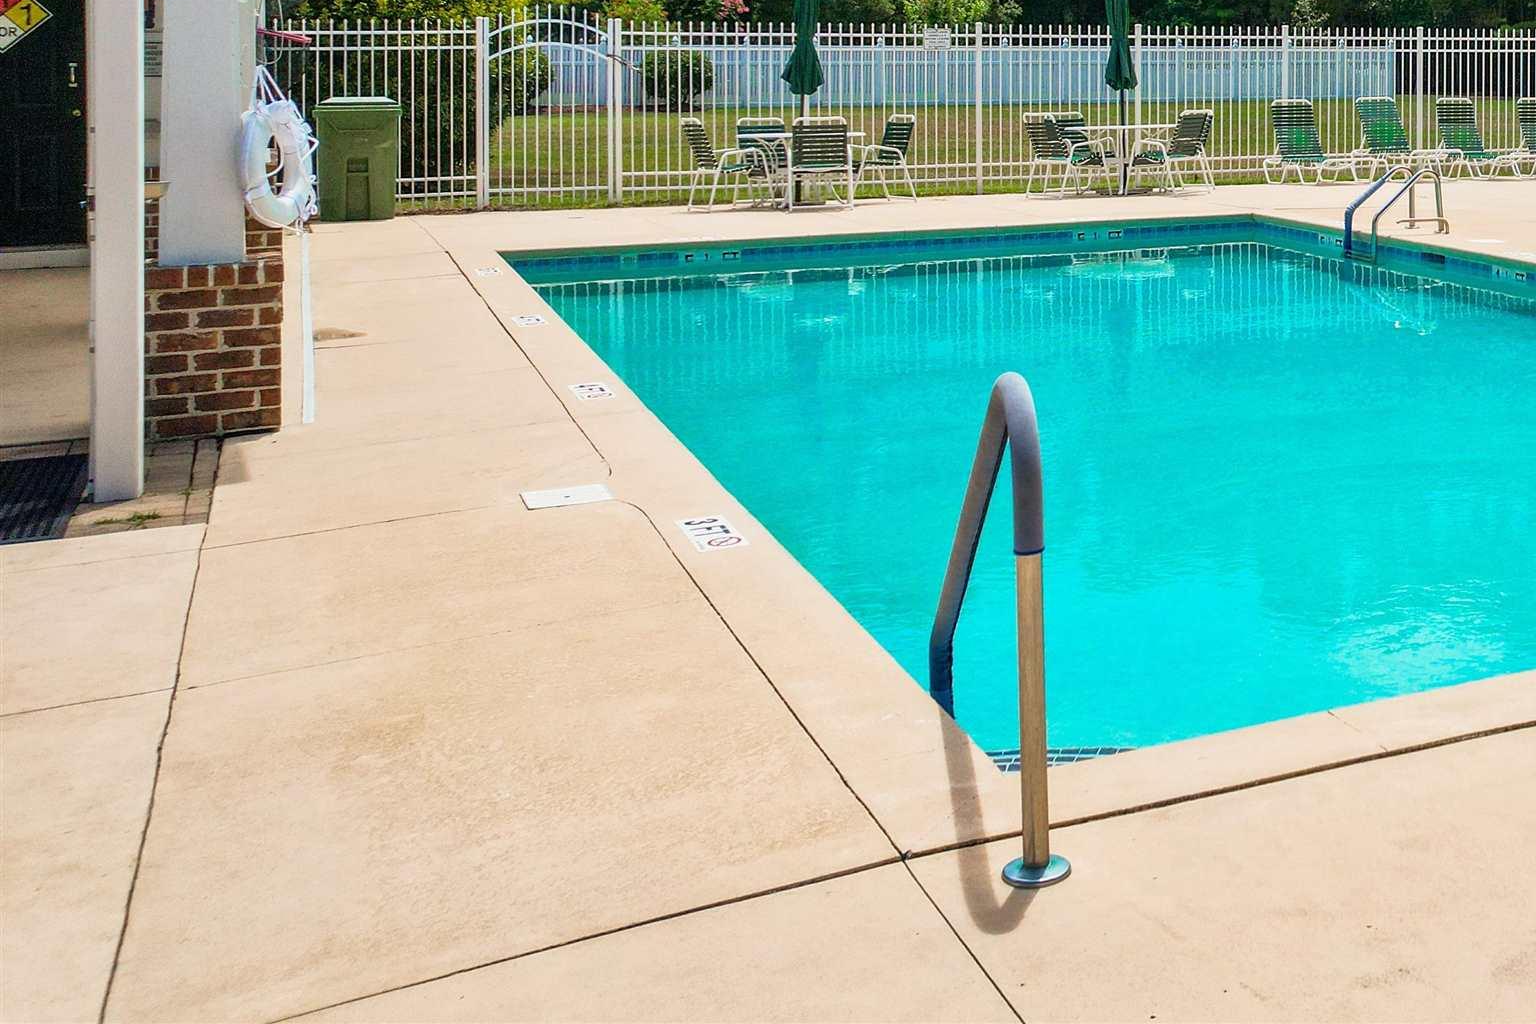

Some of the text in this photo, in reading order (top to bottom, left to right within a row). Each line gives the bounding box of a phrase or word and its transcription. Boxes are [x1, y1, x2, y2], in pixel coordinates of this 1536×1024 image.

[20, 3, 32, 26] 1
[684, 518, 731, 537] 3 FT
